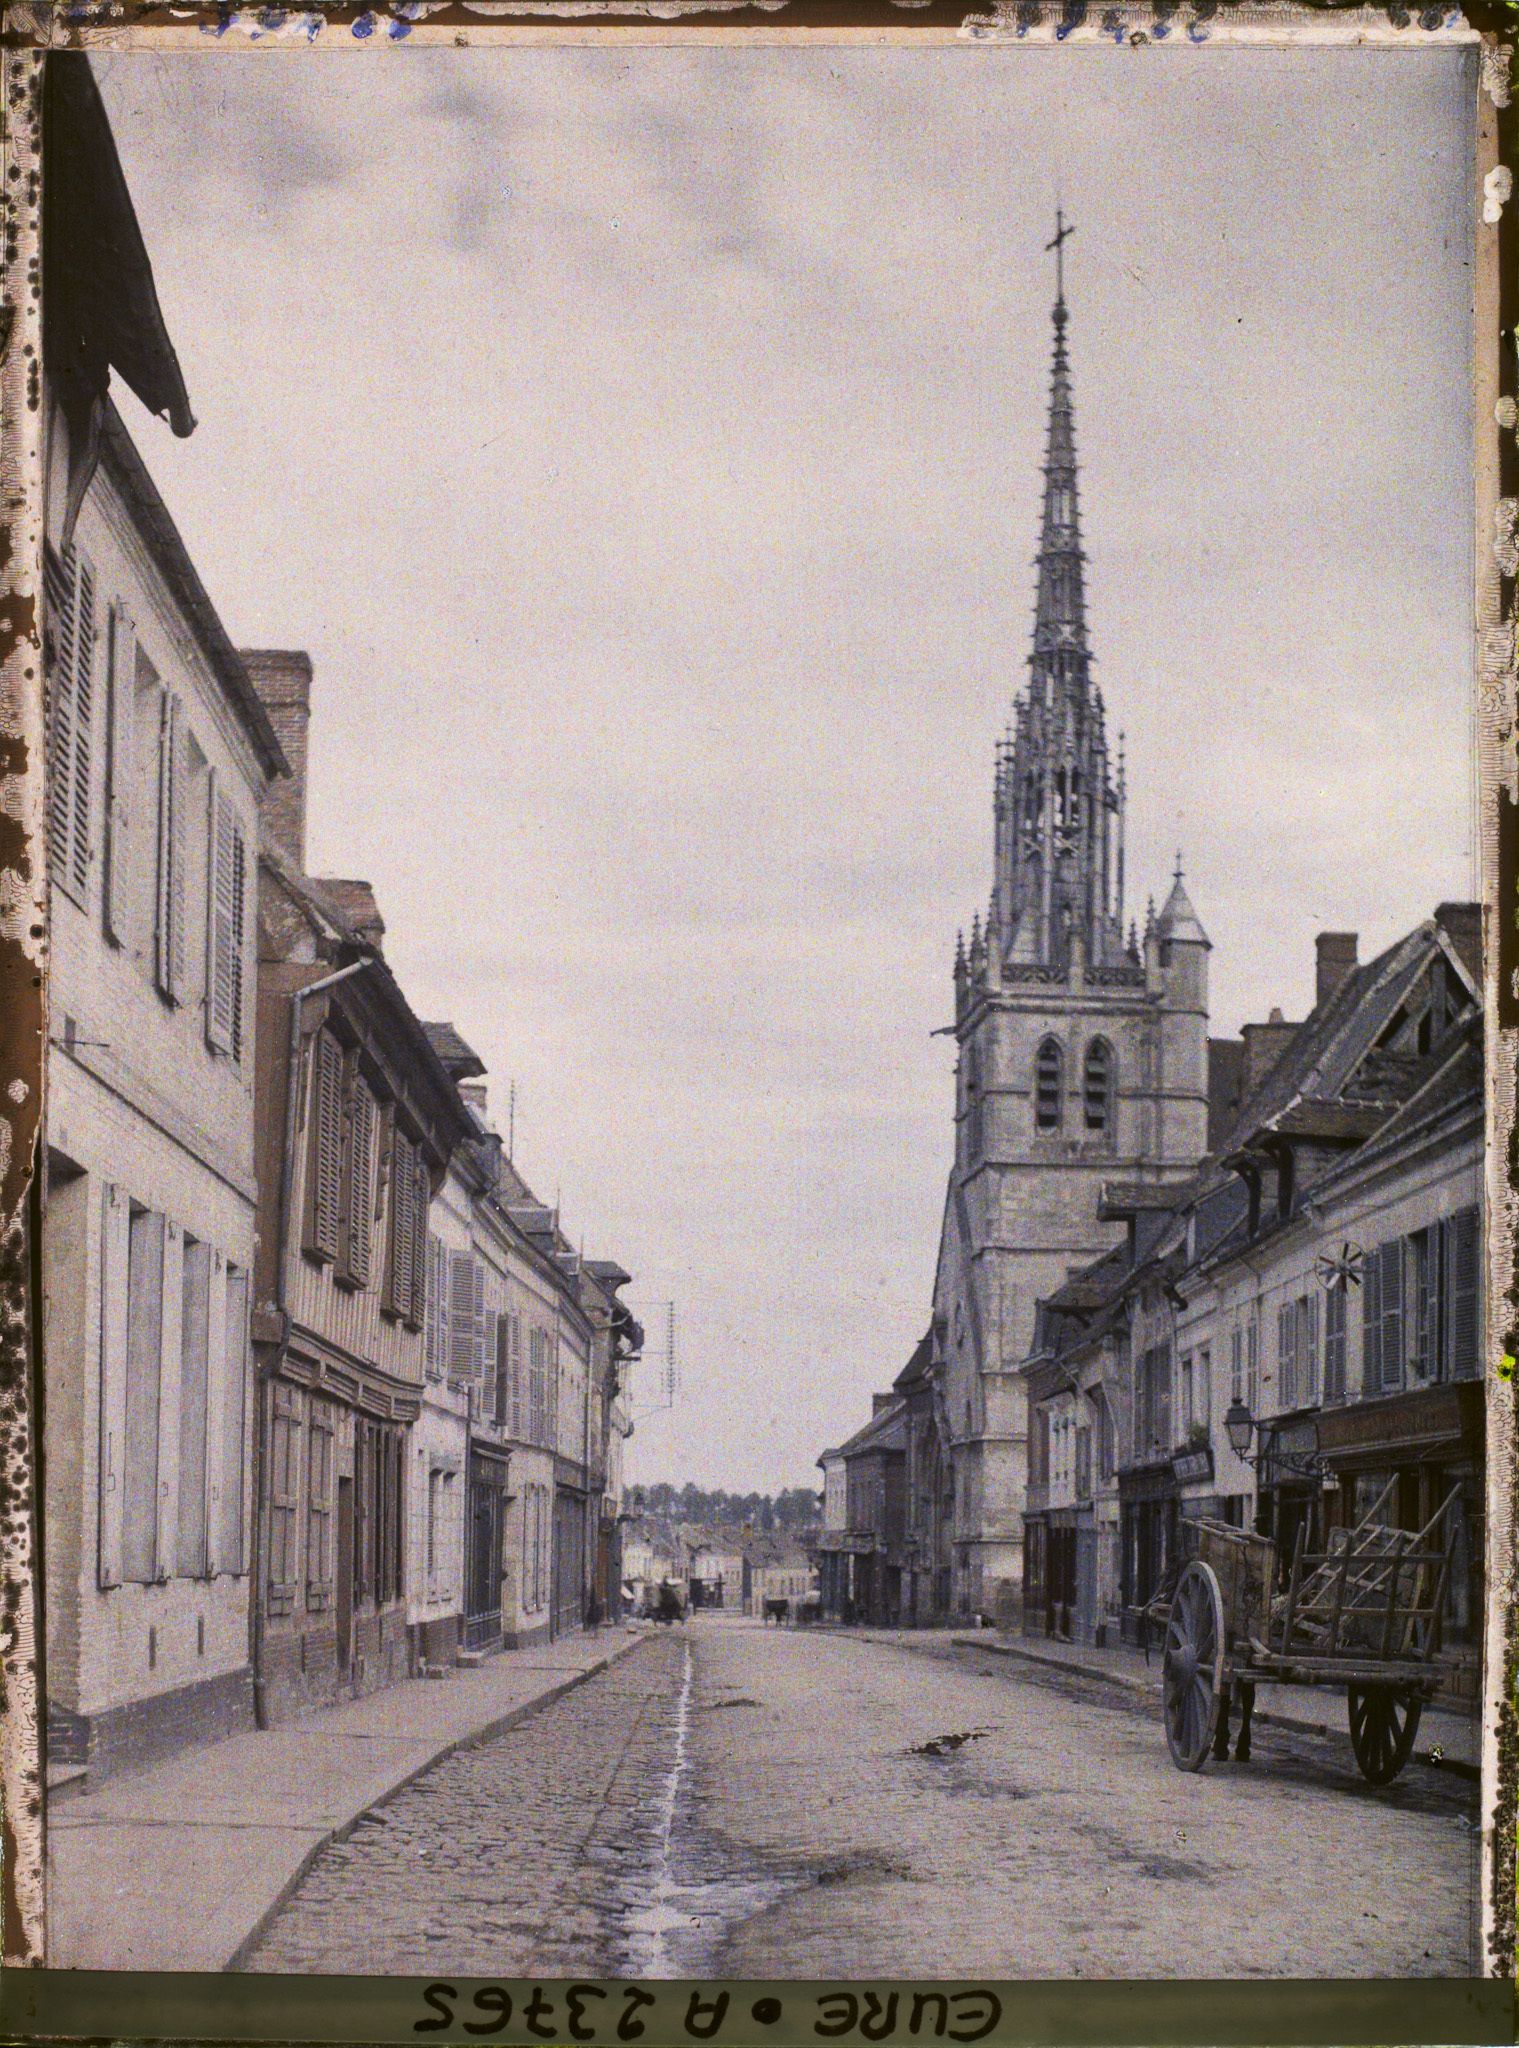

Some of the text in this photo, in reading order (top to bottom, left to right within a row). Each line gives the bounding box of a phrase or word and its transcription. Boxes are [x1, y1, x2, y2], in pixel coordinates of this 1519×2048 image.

[413, 1983, 1001, 2042] EURE A 23765
